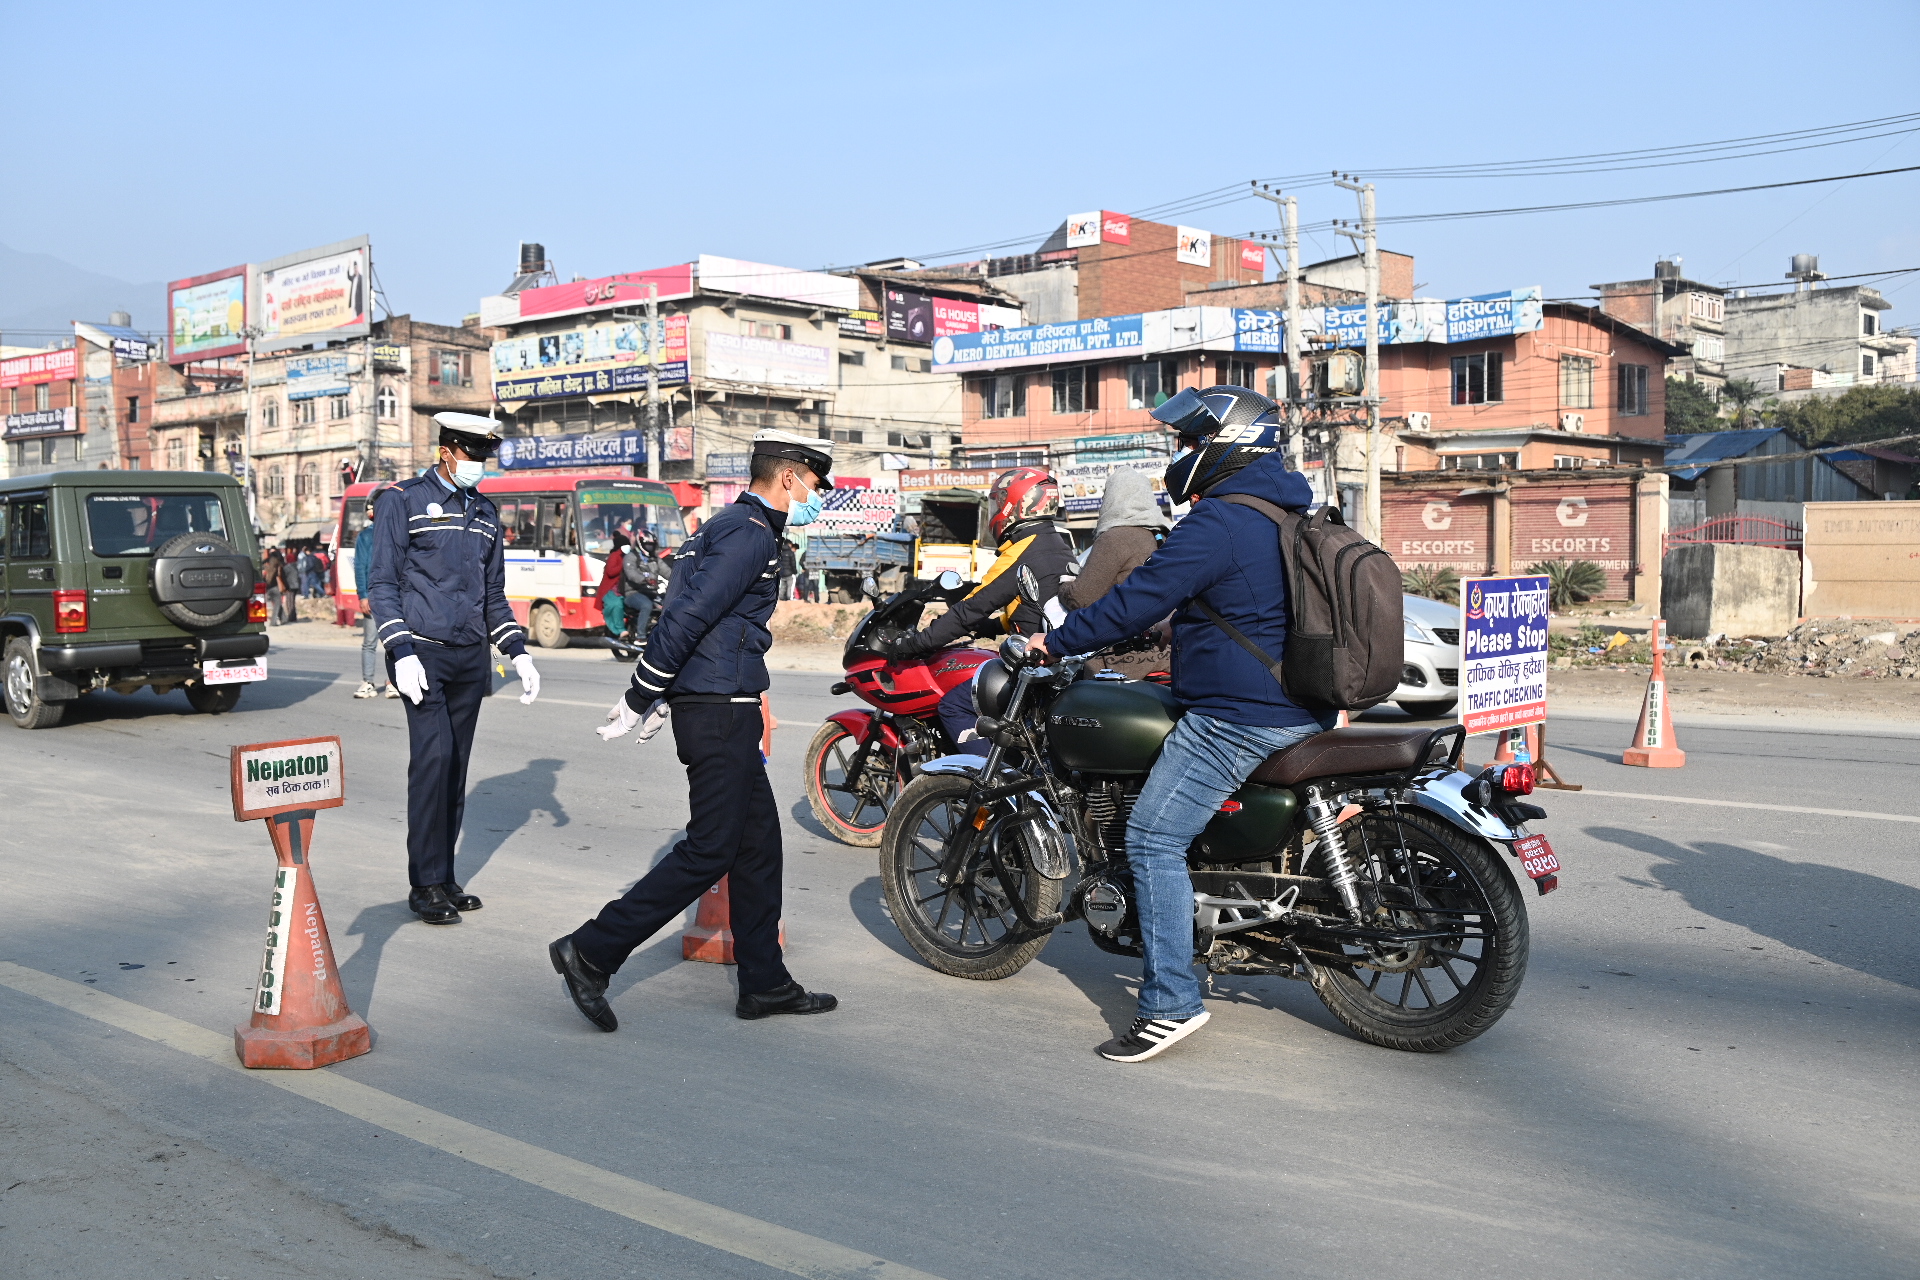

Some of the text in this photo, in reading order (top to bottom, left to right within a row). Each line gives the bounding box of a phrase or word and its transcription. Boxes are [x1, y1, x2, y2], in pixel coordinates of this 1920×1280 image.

[935, 307, 978, 324] LG HOUSE
[1448, 296, 1512, 322] हस्पिटल
[1238, 310, 1281, 333] मेरो
[1449, 314, 1513, 336] HOSPITAL
[981, 330, 999, 345] मेरो
[1003, 328, 1033, 344] डेन्टल
[1035, 324, 1077, 341] हस्पिटल
[1239, 331, 1279, 346] MERO
[710, 333, 827, 361] MERO DENTAL HOSPITAL
[954, 330, 1142, 364] MERO DENTAL HOSPITAL PVT. LTD.
[31, 355, 45, 373] JOB
[45, 350, 75, 371] CENTER
[1212, 424, 1265, 444] 93
[515, 434, 640, 460] मेरो डेन्टल हस्पिटल प्रा.
[901, 473, 933, 487] Best
[933, 471, 986, 486] Kitchen
[860, 493, 896, 506] CYCLE
[864, 509, 893, 522] SHOP
[1401, 540, 1475, 555] ESCORTS
[1531, 537, 1610, 553] ESCORTS
[1484, 592, 1510, 628] कृपया
[1467, 625, 1547, 655] Please Stop
[1468, 683, 1543, 711] TRAFFIC CHECKING
[247, 753, 329, 783] Nepatop
[265, 783, 280, 798] सब
[281, 780, 302, 796] ठिक
[302, 780, 322, 792] ठाक
[259, 870, 287, 1011] Nepatop
[303, 902, 328, 982] Nepatop
